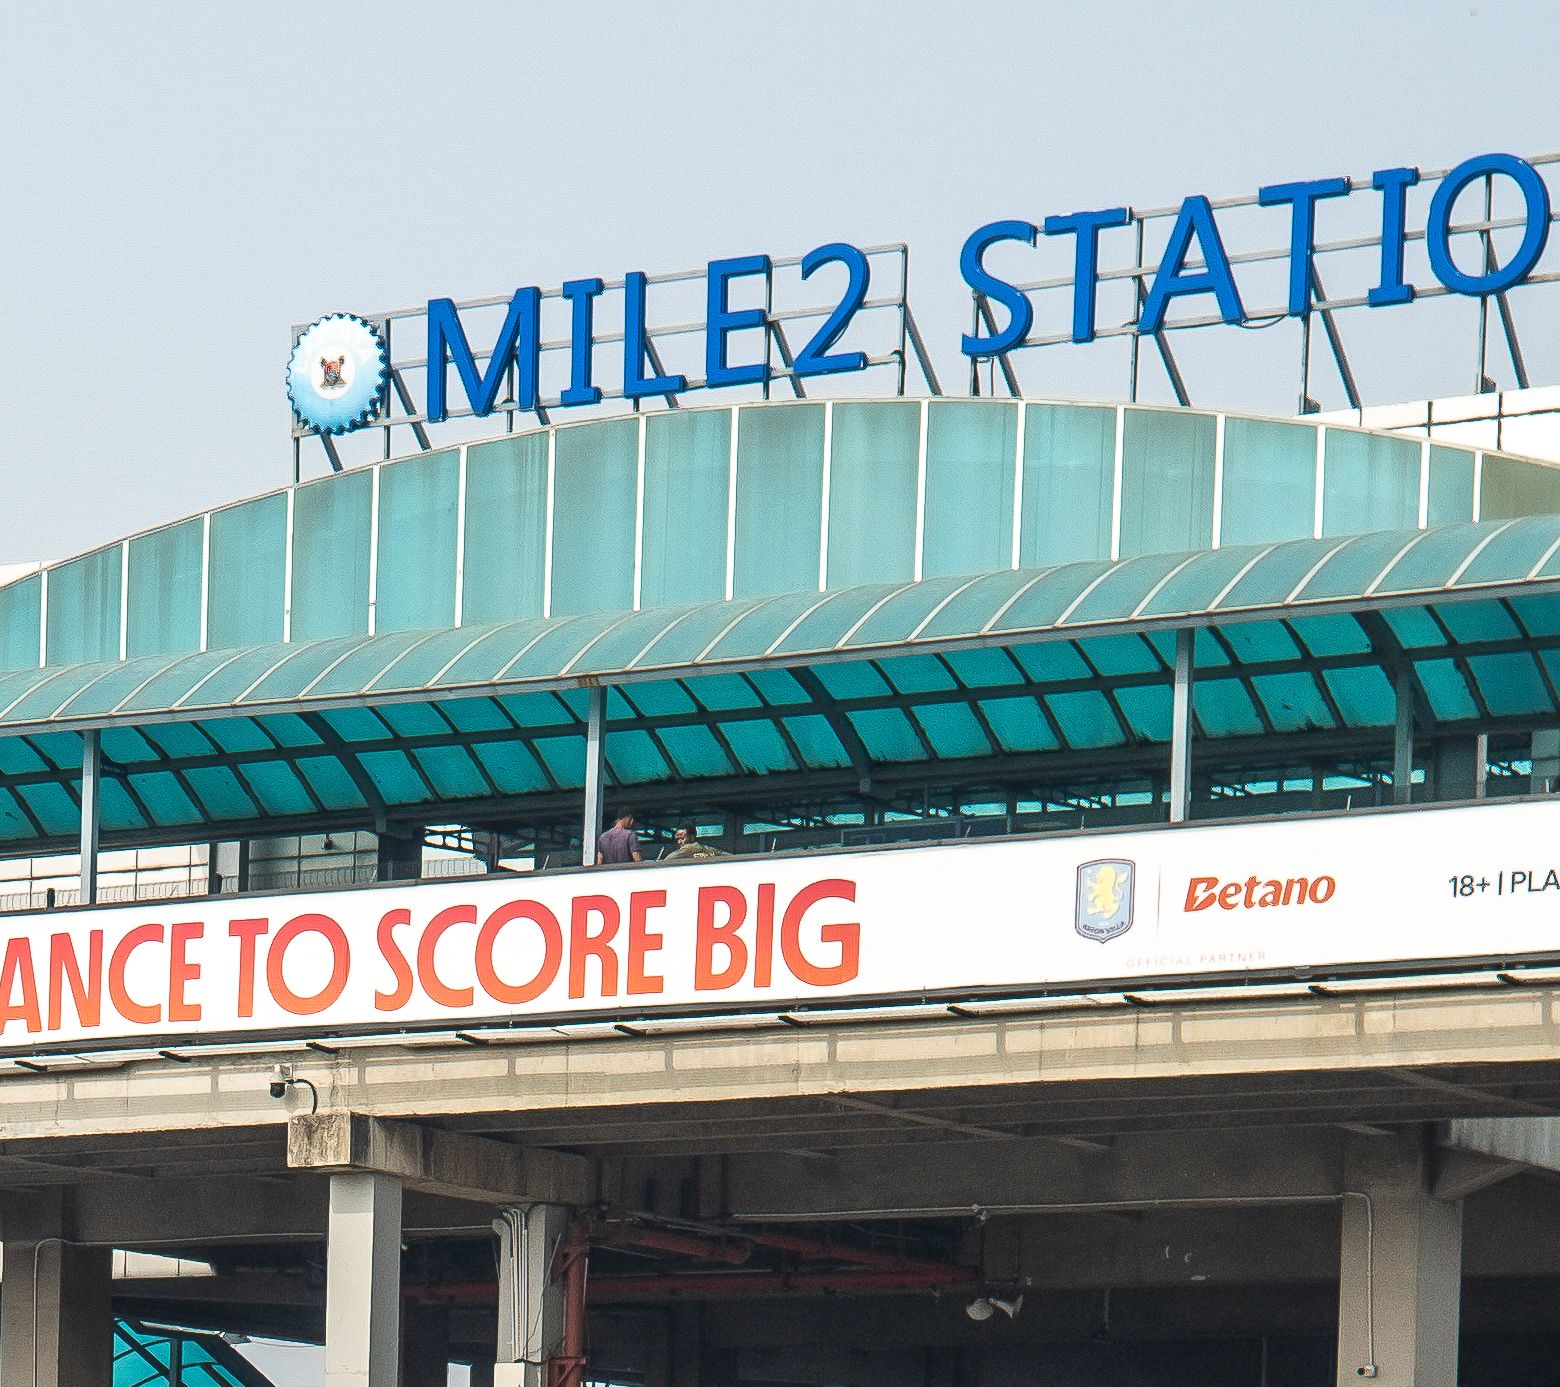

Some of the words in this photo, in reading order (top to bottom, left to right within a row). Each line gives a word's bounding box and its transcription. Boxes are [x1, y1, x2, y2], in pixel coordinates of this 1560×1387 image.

[424, 242, 869, 425] MILE2
[1183, 875, 1337, 912] Betano
[1448, 874, 1491, 899] 18+
[228, 913, 351, 1018] TO
[374, 889, 668, 1012] SCORE
[693, 878, 861, 992] BIG
[1125, 954, 1192, 969] OFFICIAL
[1199, 951, 1267, 965] PARTNER
